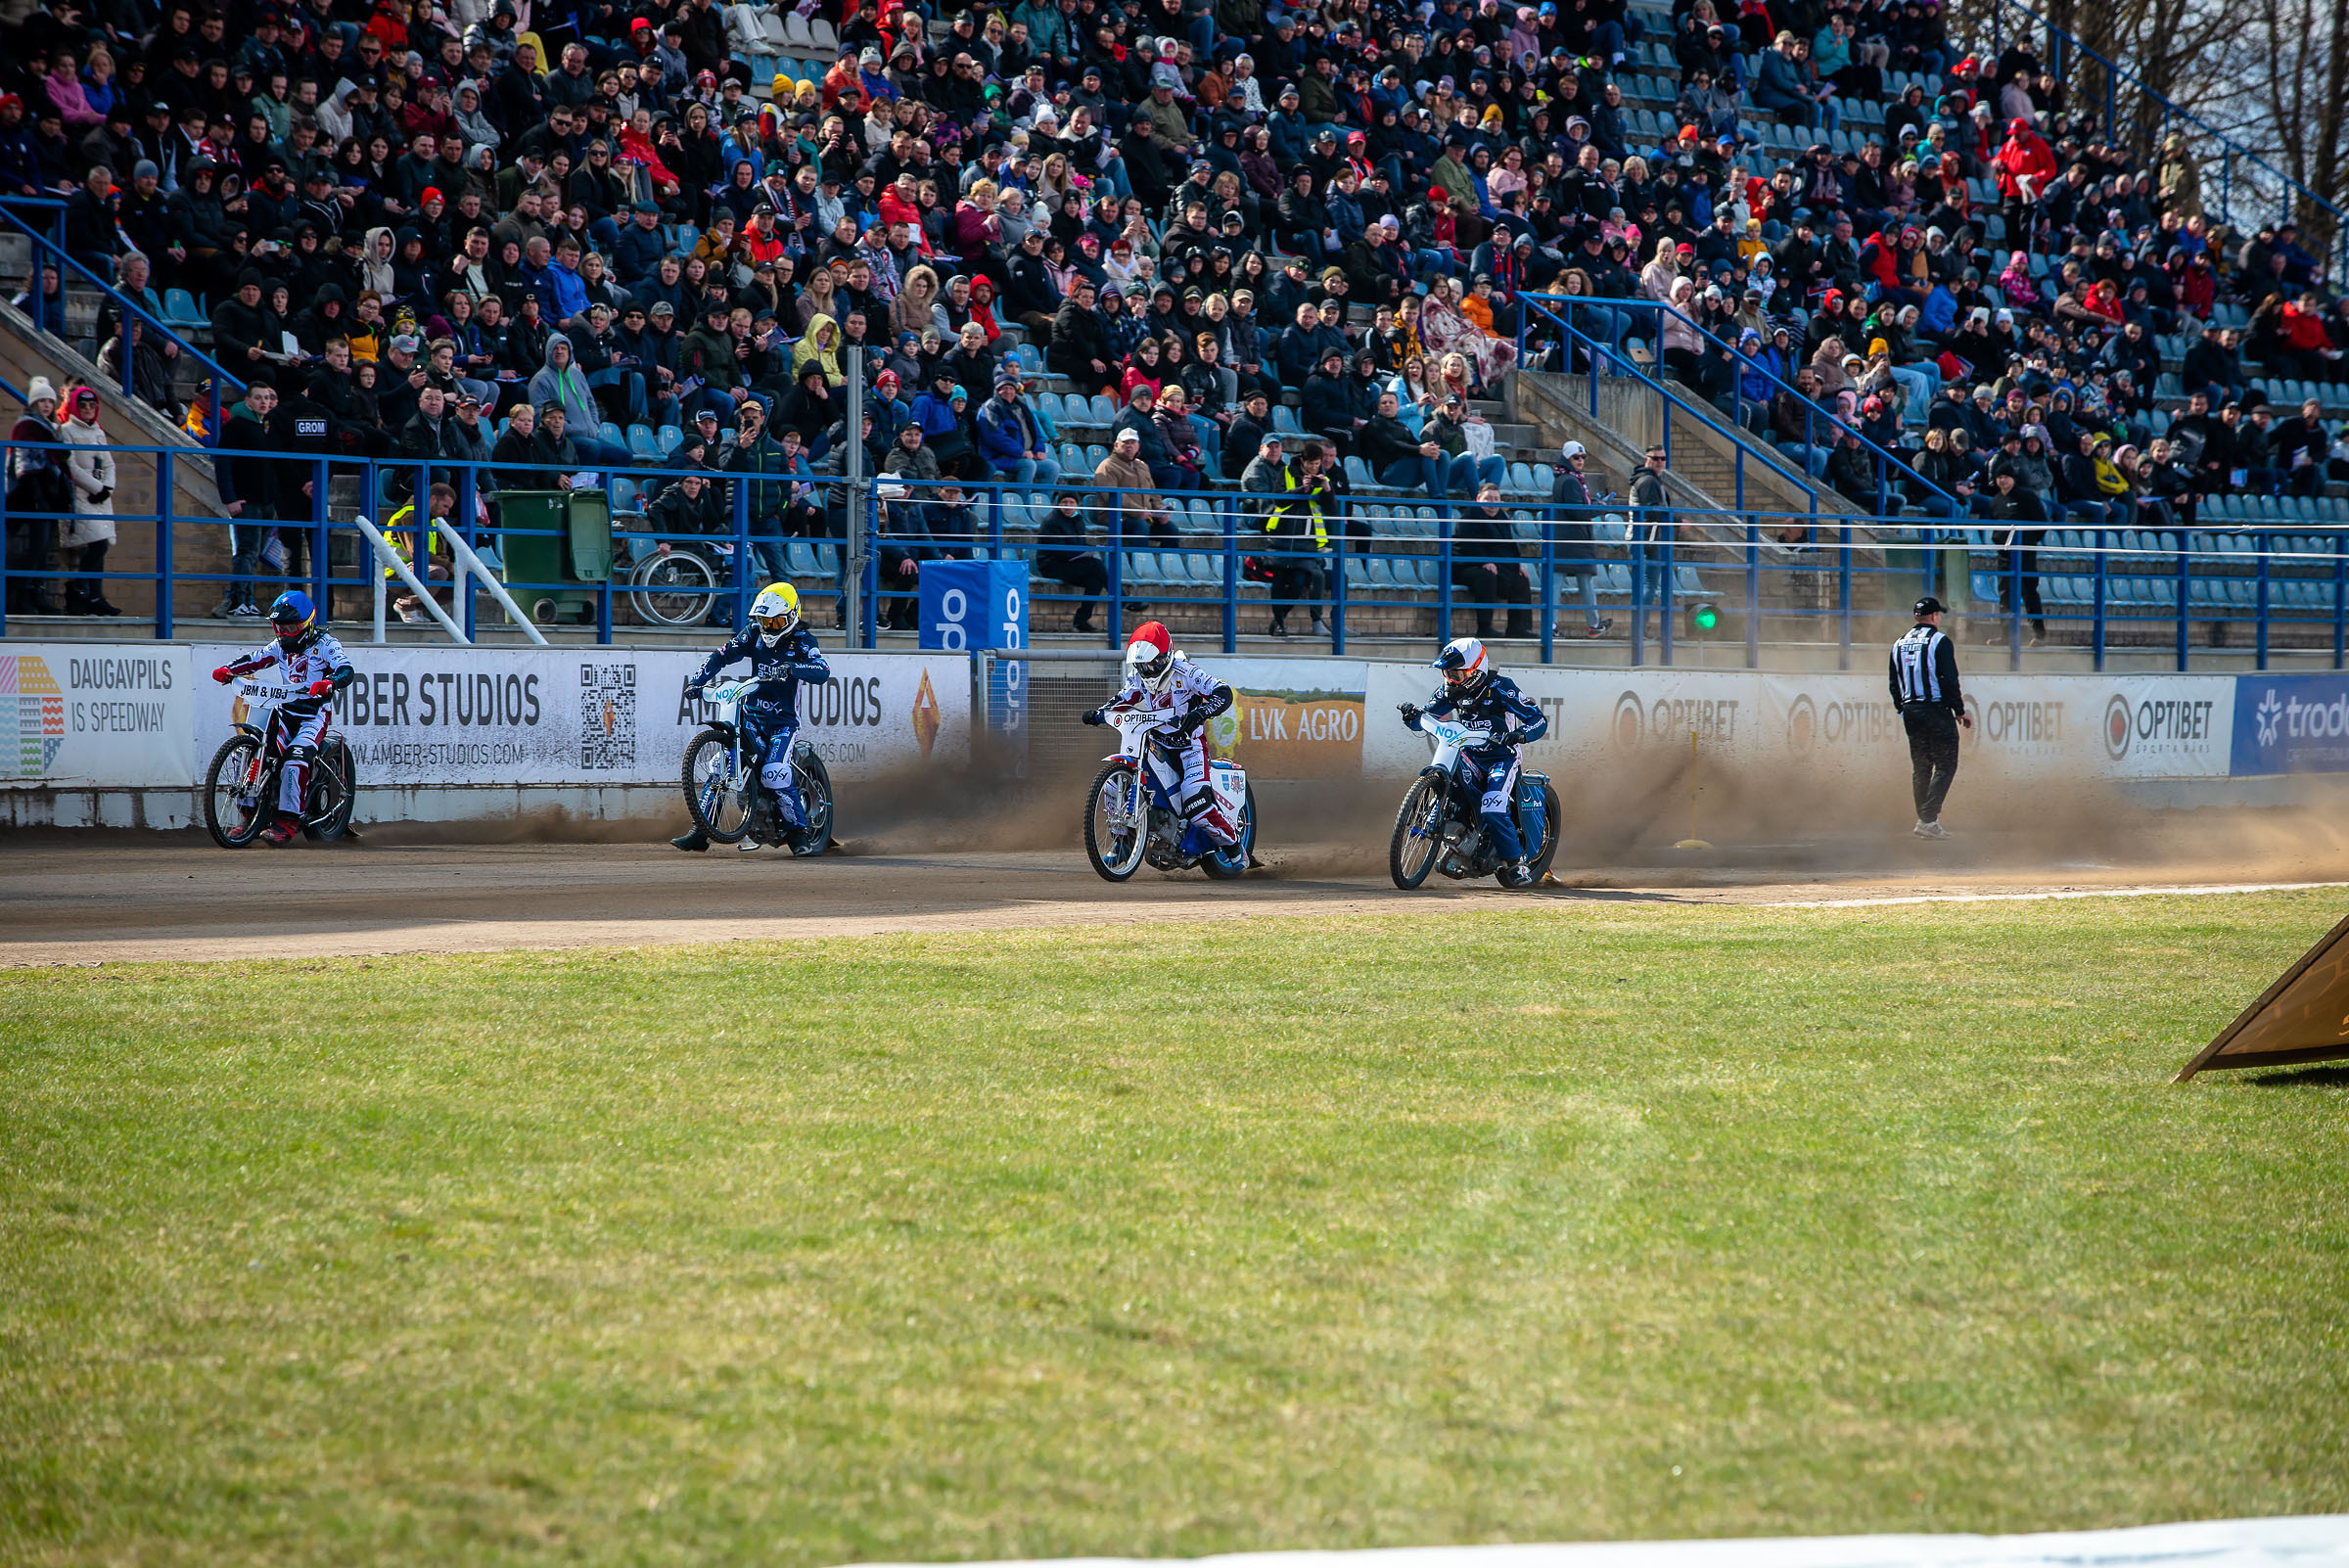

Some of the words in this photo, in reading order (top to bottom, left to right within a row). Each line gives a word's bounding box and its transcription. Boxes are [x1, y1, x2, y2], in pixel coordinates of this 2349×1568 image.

[298, 422, 325, 433] GROM
[69, 659, 172, 689] DAUGAVPILS
[241, 684, 259, 696] JBM
[259, 685, 268, 697] &
[329, 672, 410, 726] MBER
[419, 672, 540, 726] STUDIOS
[799, 676, 881, 726] UDIOS
[2286, 693, 2349, 737] trod
[71, 702, 85, 732] IS
[91, 702, 165, 732] SPEEDWAY
[1124, 714, 1157, 722] OPTIBET
[1250, 708, 1289, 741] LVK
[1298, 708, 1359, 742] AGRO
[1652, 698, 1739, 742] OPTIBET
[1987, 701, 2063, 742] OPTIBET
[2137, 700, 2213, 740] OPTIBET
[350, 744, 523, 764] W.AMBER-STUDIOS.COM
